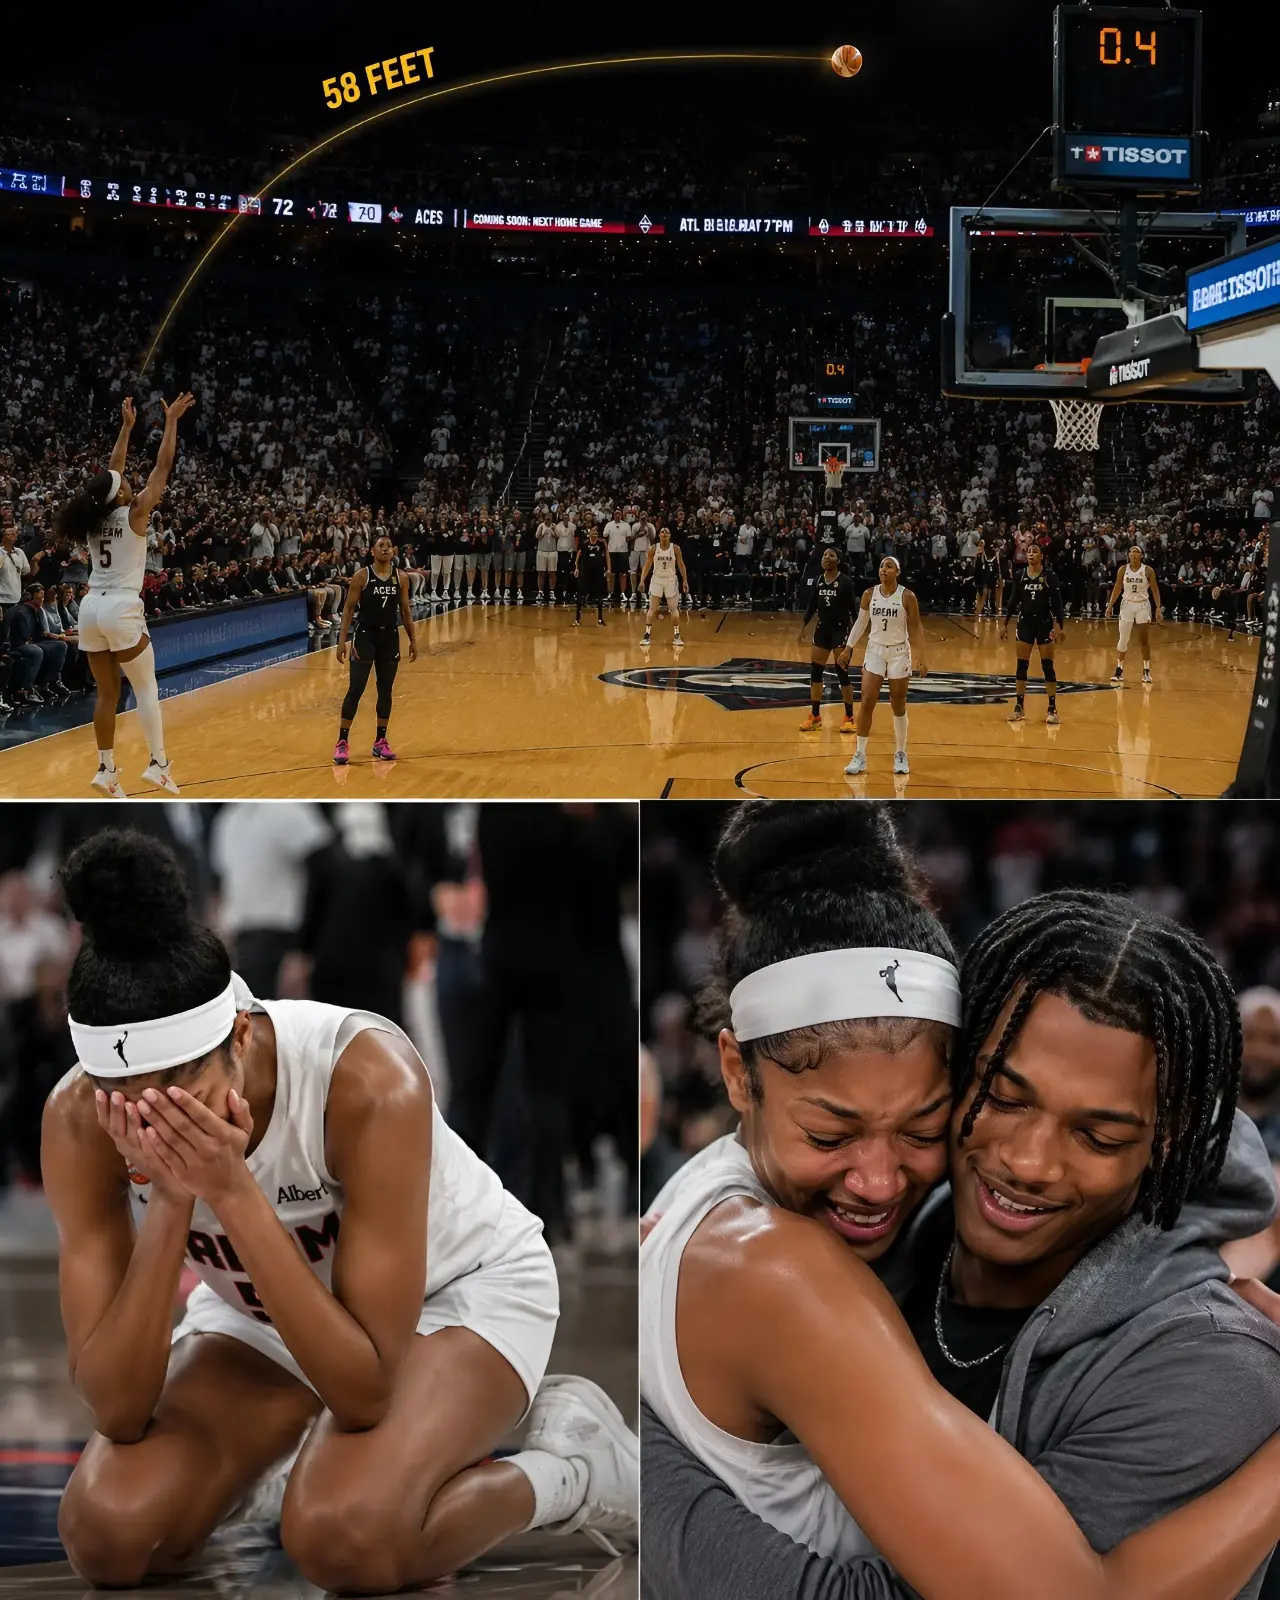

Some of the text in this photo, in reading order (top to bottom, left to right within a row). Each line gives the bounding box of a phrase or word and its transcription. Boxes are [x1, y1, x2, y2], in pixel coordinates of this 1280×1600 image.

[1100, 28, 1156, 65] 0.4
[1102, 147, 1187, 164] TISSOT
[272, 198, 294, 216] 72
[414, 209, 443, 225] ACES
[532, 216, 553, 228] NEXT
[679, 217, 700, 232] ATL
[826, 363, 845, 376] 0.4
[99, 540, 112, 569] 5
[373, 586, 397, 595] ACES
[381, 596, 388, 608] 7
[881, 619, 888, 631] 3
